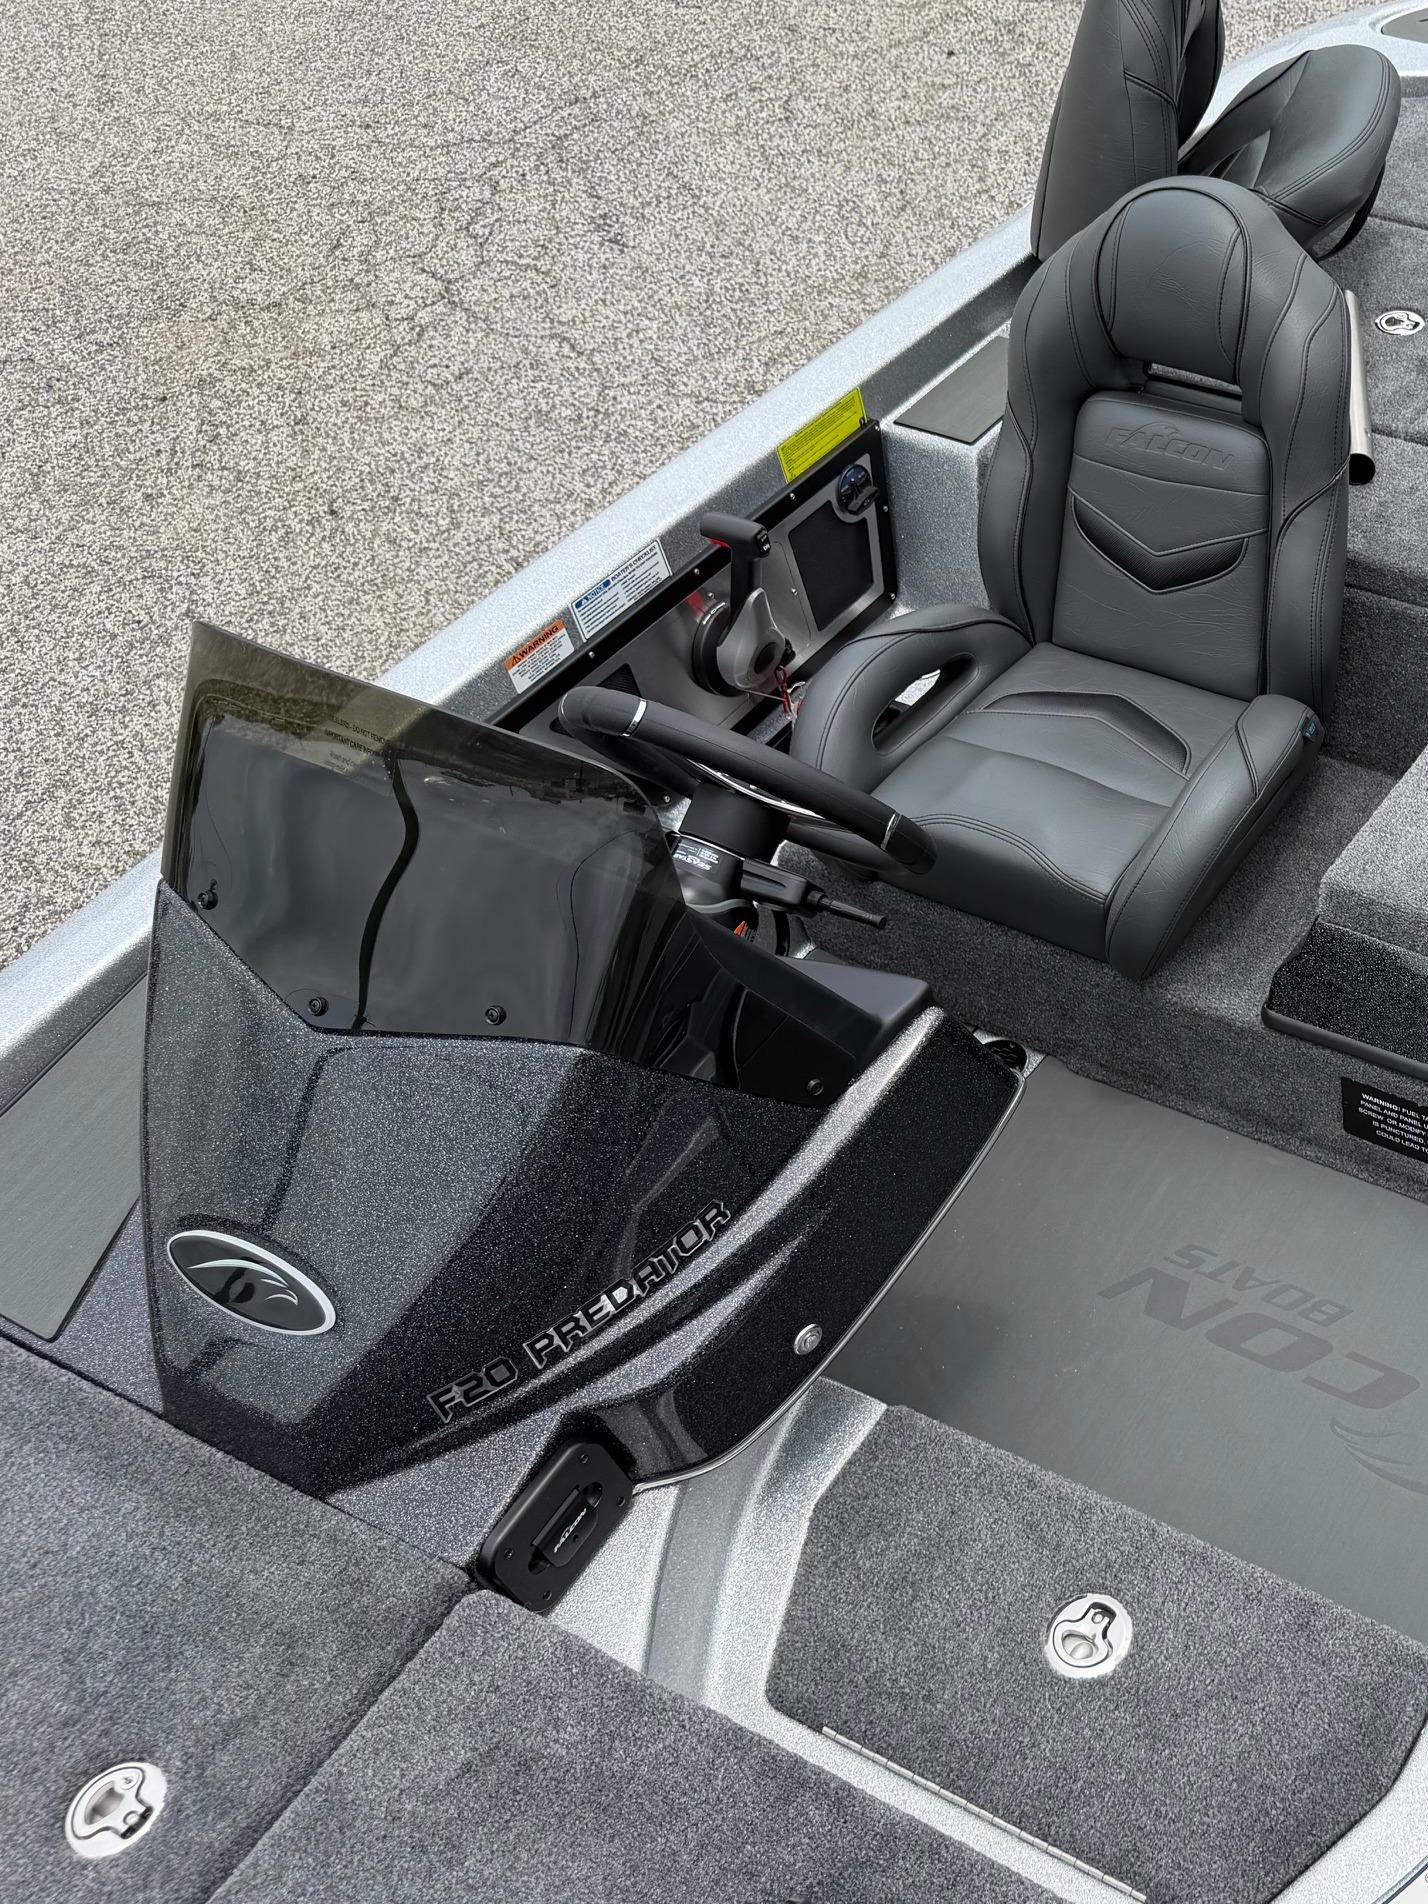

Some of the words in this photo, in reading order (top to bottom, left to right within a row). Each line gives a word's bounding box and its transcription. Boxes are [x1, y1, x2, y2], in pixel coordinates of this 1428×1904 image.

[1104, 427, 1234, 472] FALCON
[518, 625, 559, 658] WARNING
[1360, 1100, 1383, 1113] PANEL
[1383, 1109, 1398, 1118] AND
[1399, 1114, 1422, 1128] PANEL
[1386, 1118, 1398, 1127] OR
[1399, 1122, 1426, 1136] MODIFY
[1401, 1107, 1420, 1119] FUEL
[1375, 1130, 1400, 1143] COULD
[1401, 1139, 1420, 1150] LEAD
[1162, 1244, 1354, 1327] BOATS
[427, 1356, 518, 1423] F20
[523, 1200, 731, 1369] PREDATOR
